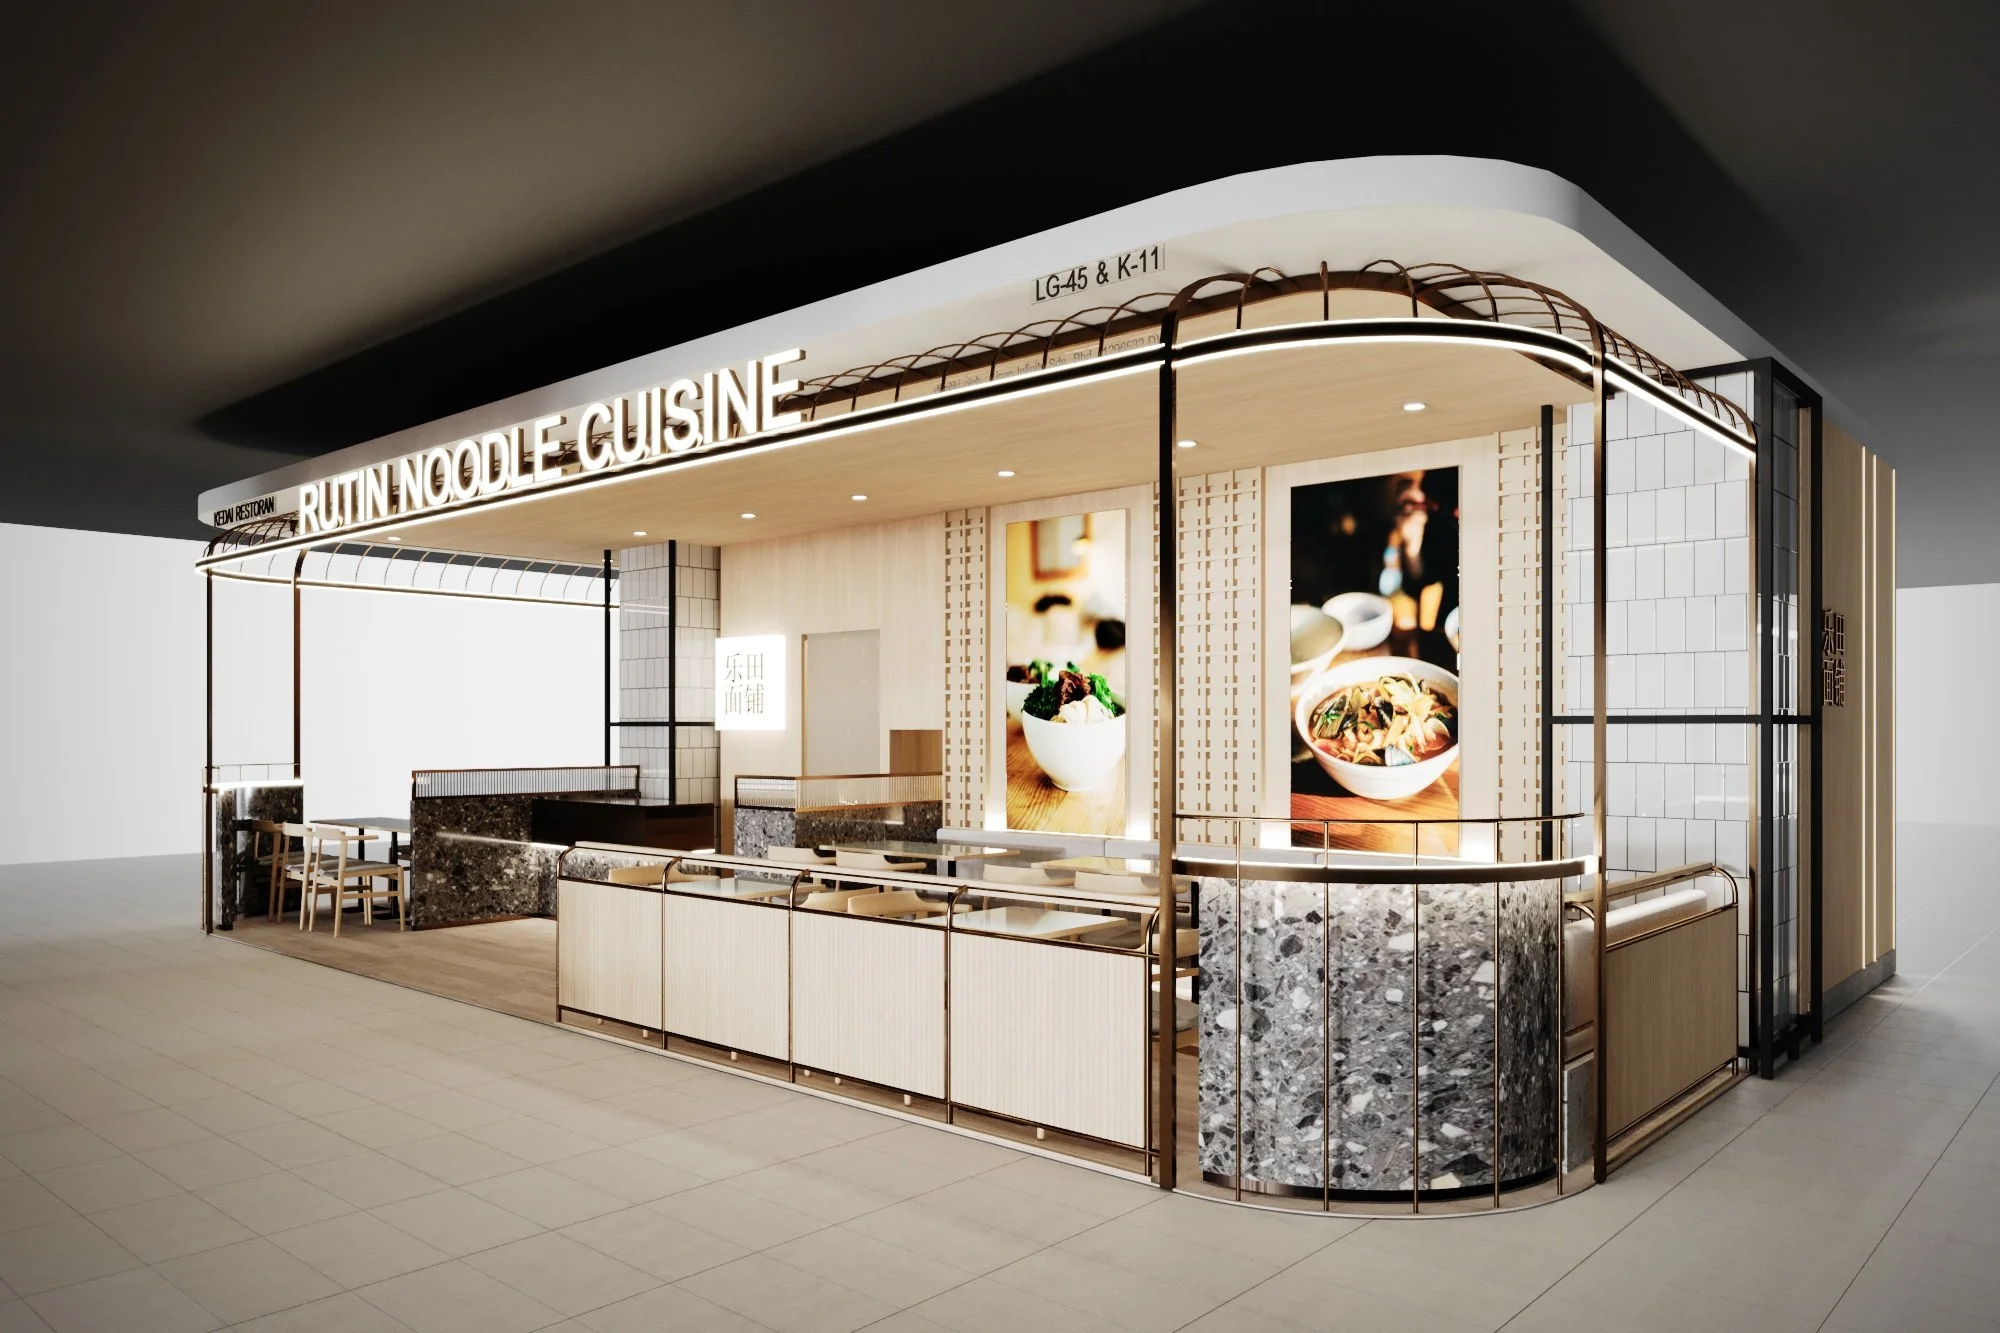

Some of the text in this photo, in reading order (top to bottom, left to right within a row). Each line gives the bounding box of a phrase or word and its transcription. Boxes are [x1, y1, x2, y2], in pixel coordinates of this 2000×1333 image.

[1036, 246, 1158, 301] LG-45 & K-11
[300, 348, 804, 535] RUTIN NOODLE CUISINE
[214, 496, 274, 526] KEDAI RESTORAN
[725, 653, 763, 682] 乐田
[725, 683, 763, 714] 面铺
